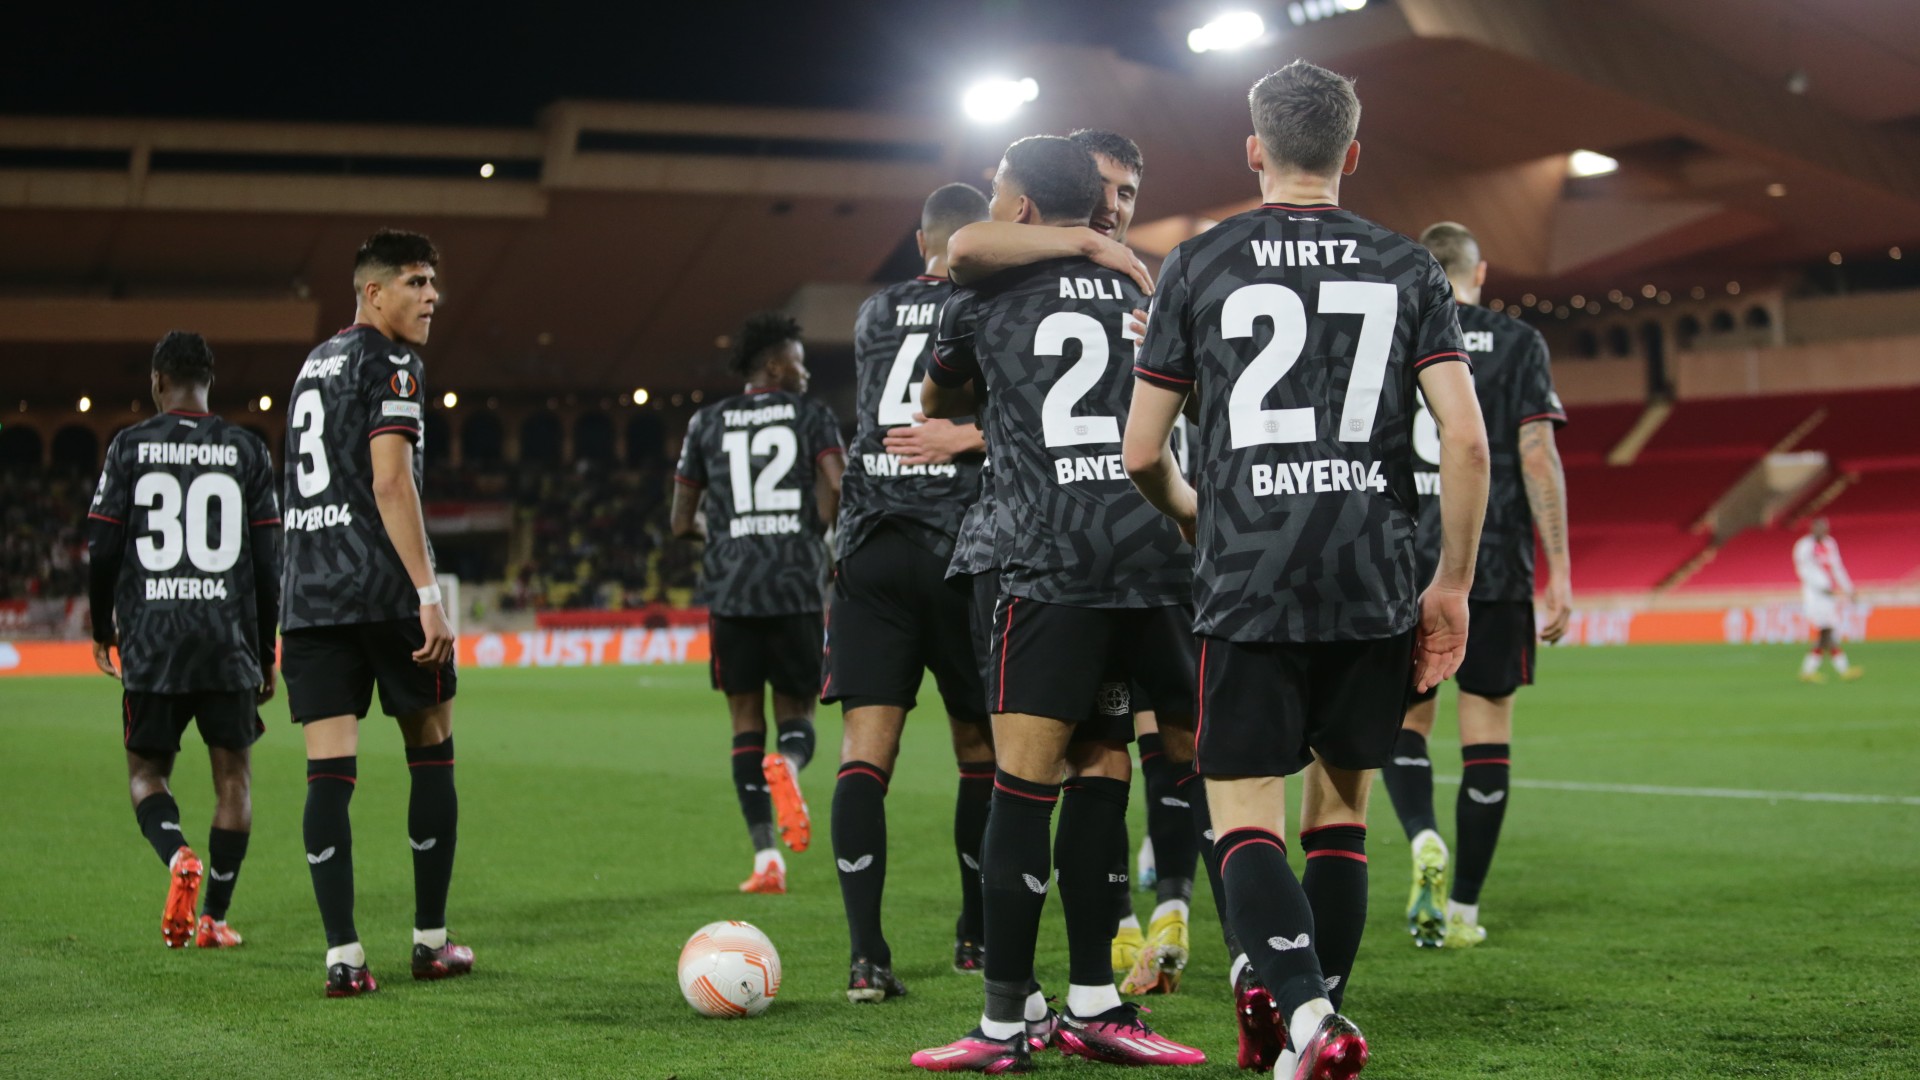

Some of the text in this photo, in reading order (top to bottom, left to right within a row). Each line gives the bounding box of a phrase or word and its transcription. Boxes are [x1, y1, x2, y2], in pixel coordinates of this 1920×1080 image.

[1251, 240, 1360, 267] WIRTZ
[1059, 276, 1123, 300] ADLI
[896, 303, 936, 326] TAH
[300, 354, 348, 379] NCAPIE
[878, 333, 930, 428] 4
[1221, 281, 1398, 450] 27
[723, 404, 796, 427] TAPSOBA
[138, 442, 238, 467] FRIMPONG
[292, 388, 331, 499] 3
[722, 425, 801, 514] 12
[1054, 454, 1130, 485] BAYE
[134, 471, 243, 573] 30
[285, 503, 352, 532] AYER04
[516, 627, 699, 668] JUST EAT
